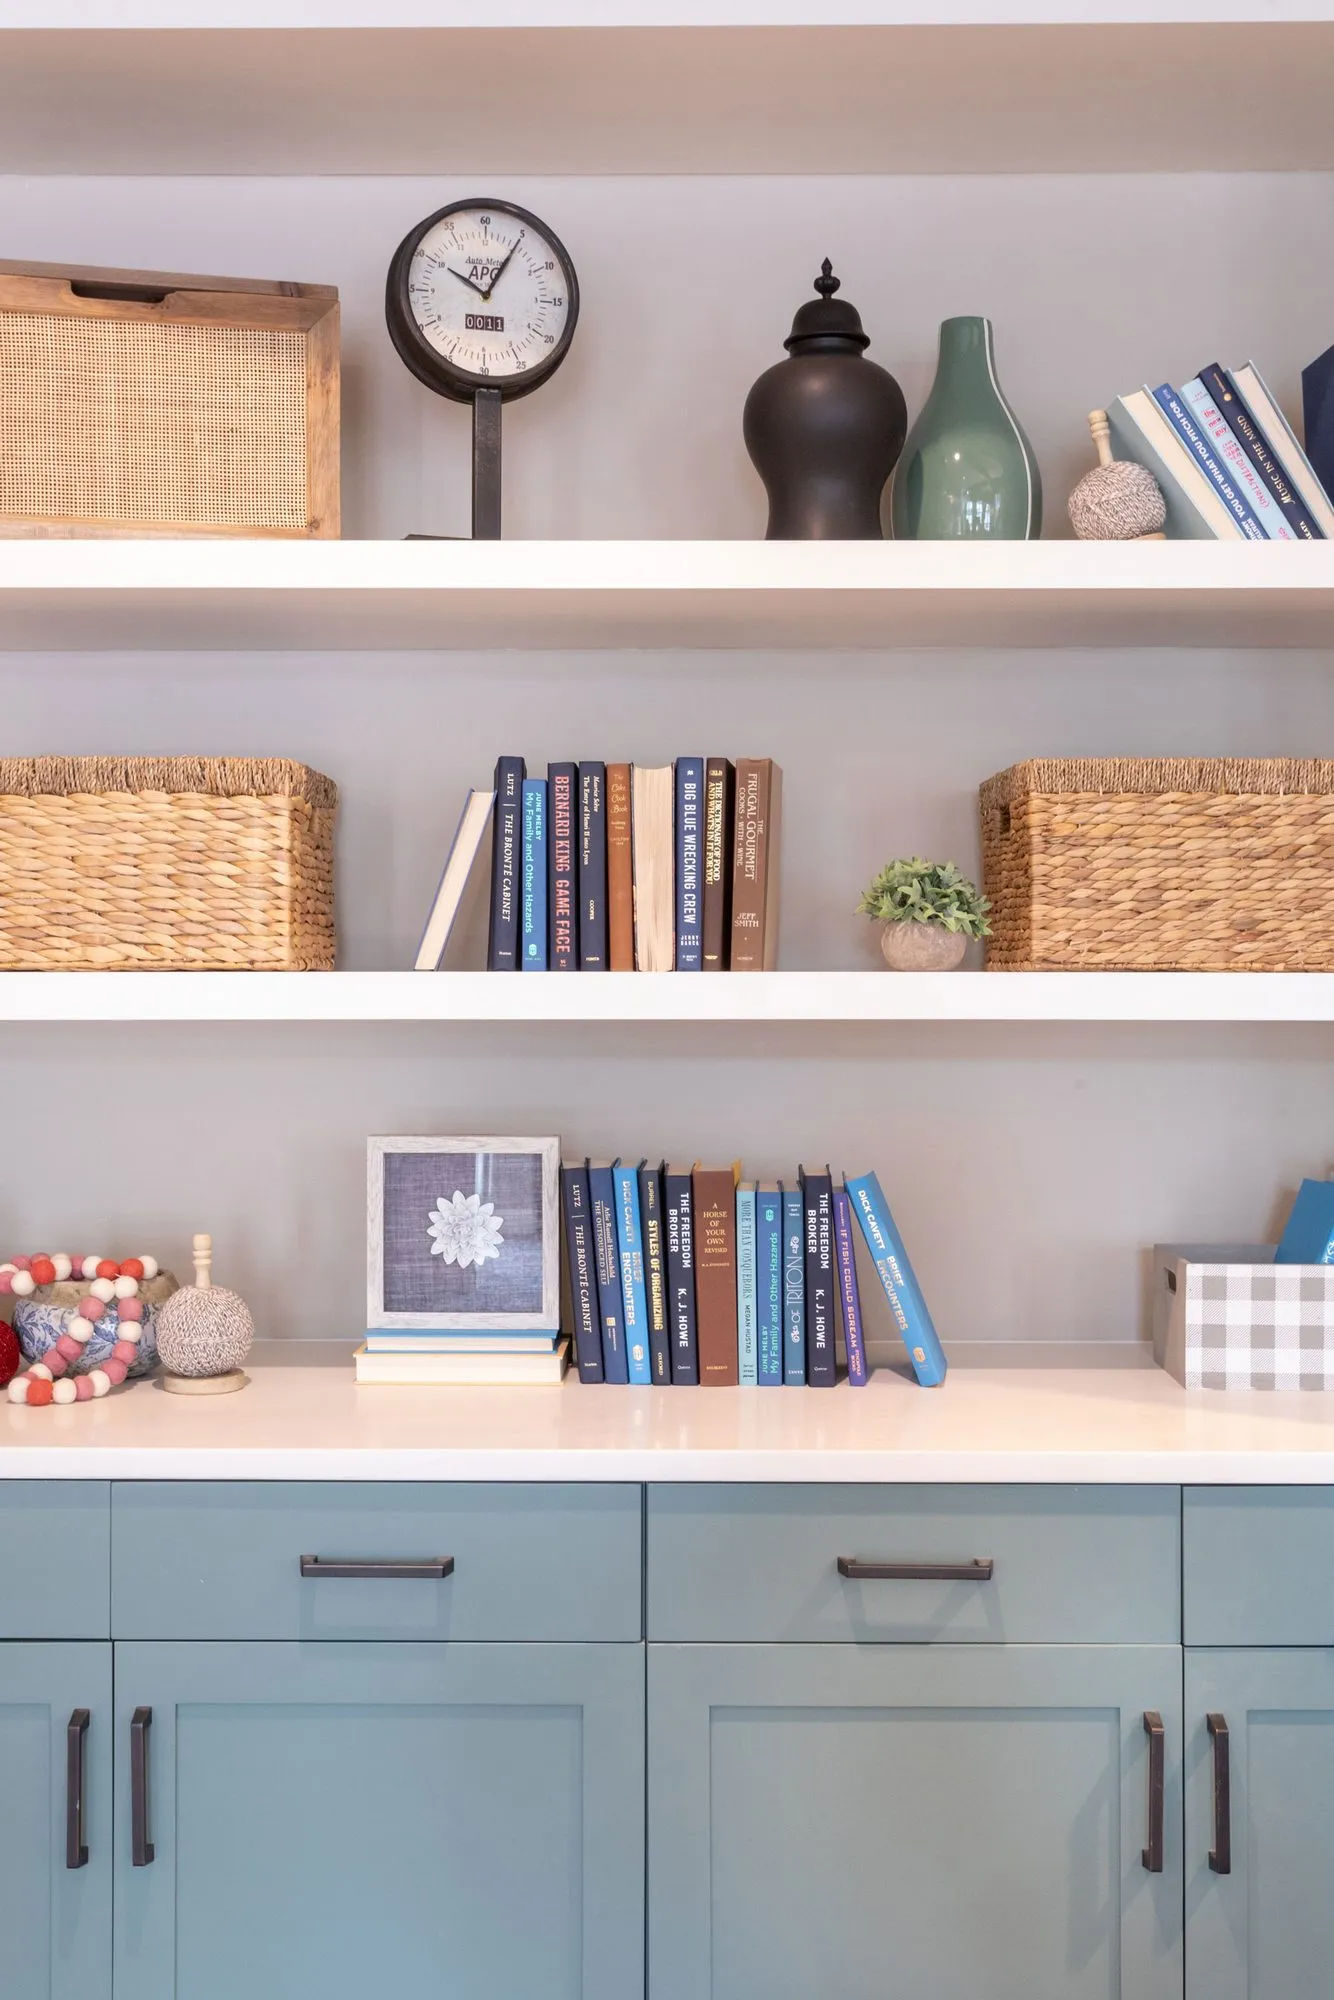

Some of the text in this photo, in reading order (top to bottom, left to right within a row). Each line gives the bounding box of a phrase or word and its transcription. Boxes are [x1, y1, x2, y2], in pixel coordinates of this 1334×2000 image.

[444, 222, 455, 231] 55
[480, 216, 491, 225] 60
[520, 230, 526, 238] 5
[465, 256, 505, 267] Auto Mete
[544, 262, 554, 270] 10
[552, 298, 562, 306] 15
[466, 315, 503, 330] 0011
[544, 334, 554, 344] 20
[479, 368, 490, 376] 30
[516, 360, 526, 370] 25
[1236, 415, 1257, 441] MIND
[1170, 401, 1248, 518] YOU GET WHAT YOU PITCH FOR
[1252, 442, 1269, 462] THE
[1263, 460, 1275, 474] IN
[1270, 475, 1296, 506] MUSIC
[506, 773, 514, 796] LUTZ
[504, 814, 514, 835] THE
[554, 776, 570, 872] BERNARD KING
[707, 831, 714, 840] IN
[714, 800, 722, 847] DICTIONARY
[745, 773, 758, 880] FRUGAL GOURMET
[684, 782, 697, 924] BIG BLUE WRECKING CREW
[706, 842, 714, 850] IT
[714, 847, 721, 859] OF
[524, 792, 534, 933] My Family and Other Hazards
[502, 878, 512, 922] CABINET
[556, 880, 570, 916] GAME
[556, 920, 570, 952] FACE
[734, 920, 759, 928] SMITH
[572, 1184, 580, 1208] LUTZ
[622, 1180, 632, 1204] DICK
[703, 1210, 727, 1218] HORSE
[858, 1190, 886, 1250] DICK CAVETT
[576, 1225, 585, 1246] THE
[595, 1218, 606, 1267] OUTSOURCED
[669, 1209, 678, 1253] BROKER
[680, 1192, 691, 1268] THE FREEDOM
[808, 1209, 817, 1254] BROKER
[820, 1193, 830, 1269] THE FREEDOM
[841, 1229, 848, 1238] IF
[741, 1200, 752, 1300] MORE THAN CONQUERORS
[770, 1232, 778, 1272] Hazards
[648, 1220, 664, 1331] STYLES OF ORGANIZING
[786, 1256, 803, 1306] TRITON
[844, 1268, 853, 1302] COULD
[887, 1256, 904, 1286] BRIEF
[622, 1252, 636, 1326] ENCOUNTERS
[877, 1260, 908, 1331] ENCOUNTERS
[580, 1288, 592, 1333] CABINET
[678, 1288, 688, 1348] K. J. HOWE
[816, 1289, 826, 1348] K. J. HOWE
[770, 1324, 778, 1357] Family
[848, 1306, 857, 1348] SCREAM
[770, 1360, 779, 1374] My
